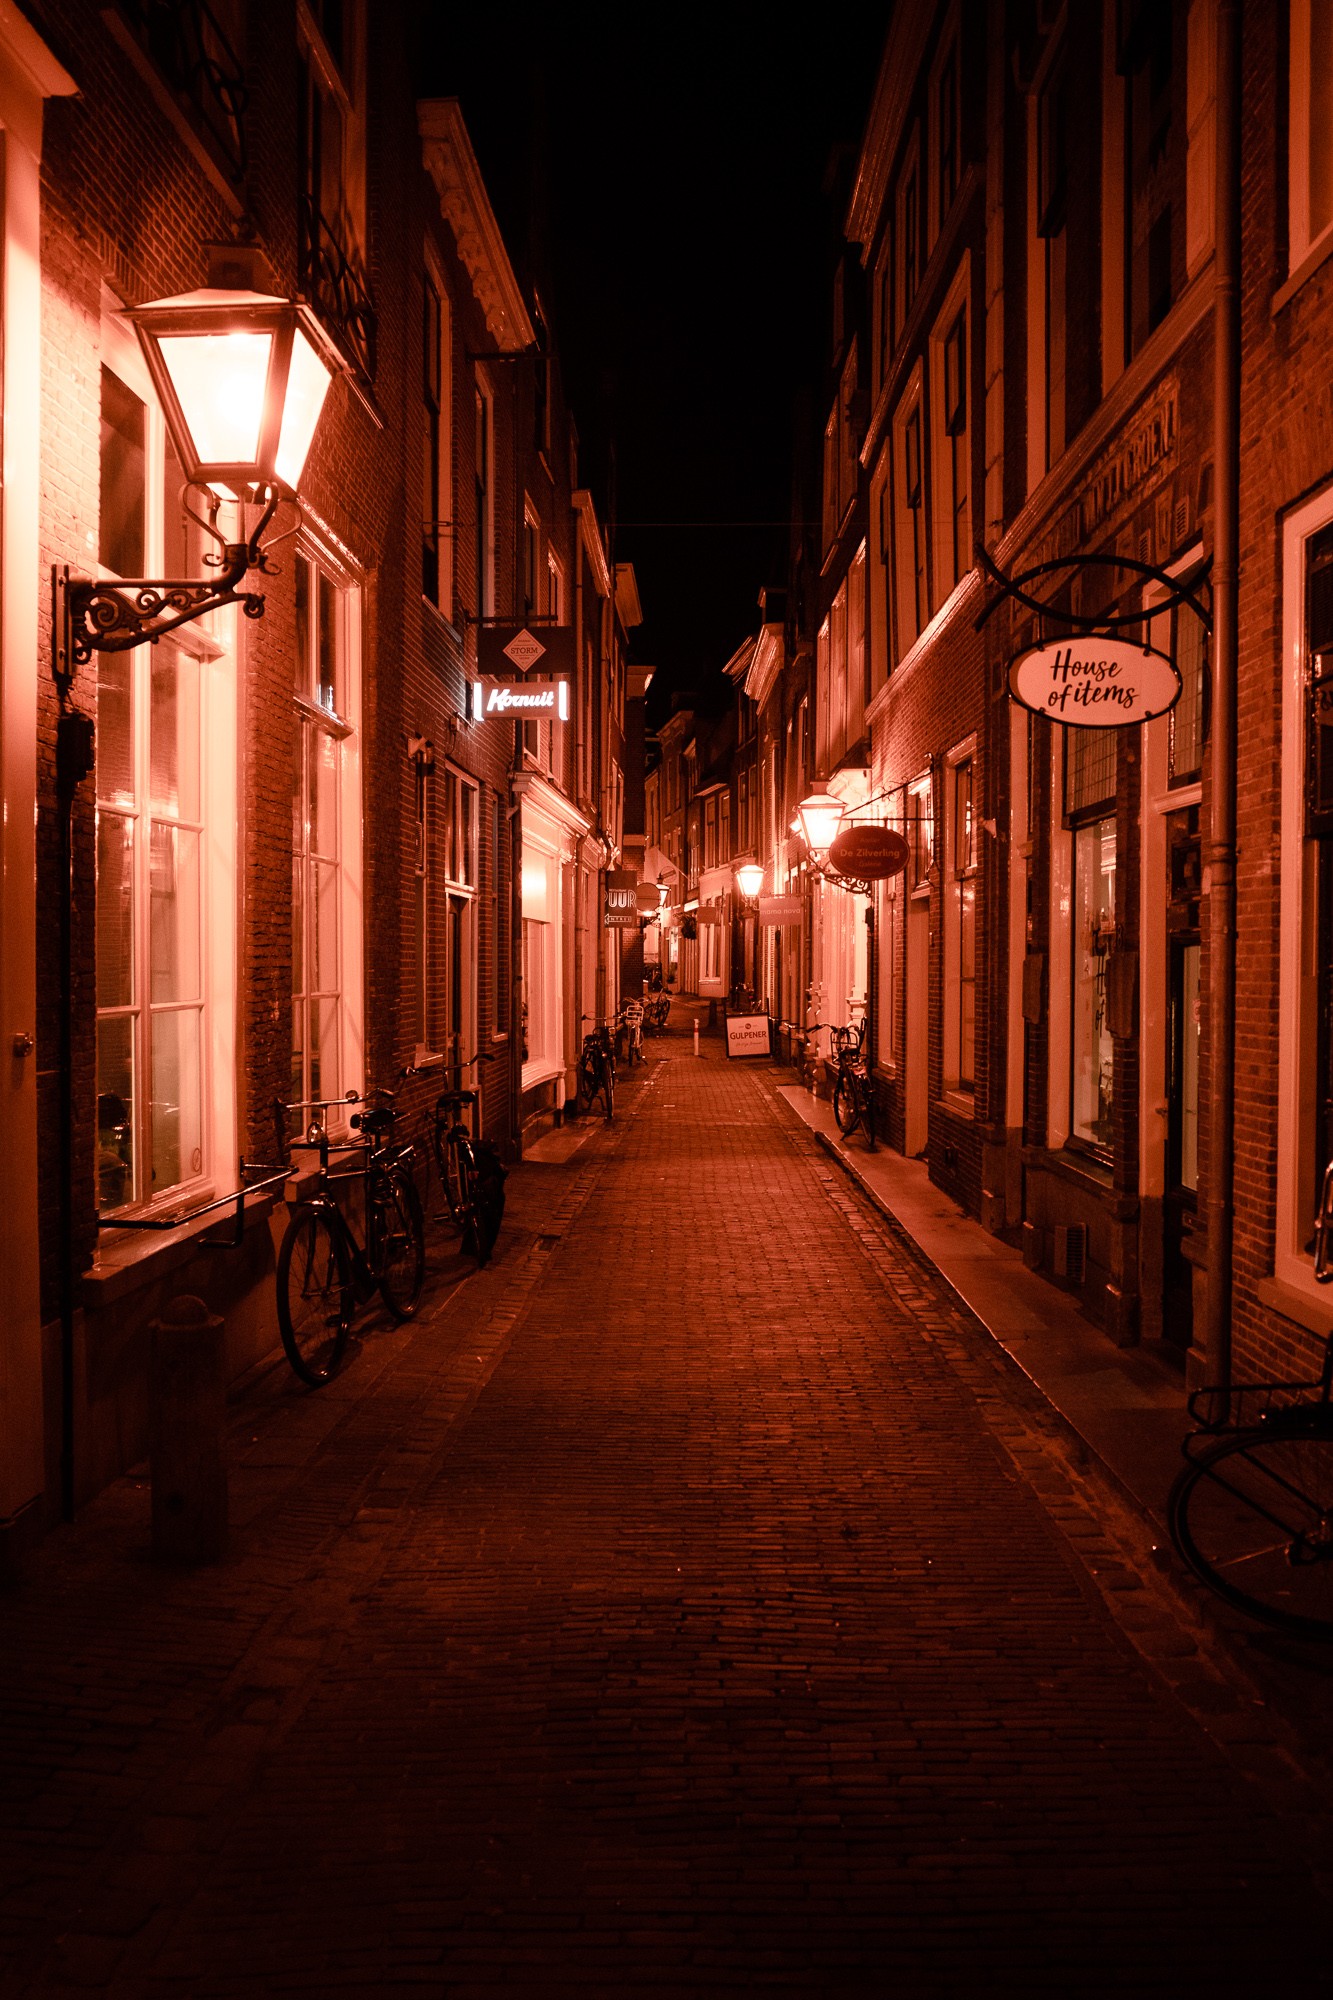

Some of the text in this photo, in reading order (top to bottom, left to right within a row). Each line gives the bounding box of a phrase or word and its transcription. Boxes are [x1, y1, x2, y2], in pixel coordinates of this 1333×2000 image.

[1050, 648, 1123, 683] House
[487, 689, 554, 711] Kornuit
[1048, 680, 1140, 712] of items
[856, 848, 900, 859] Zilverling
[730, 1031, 767, 1040] GULPENER
